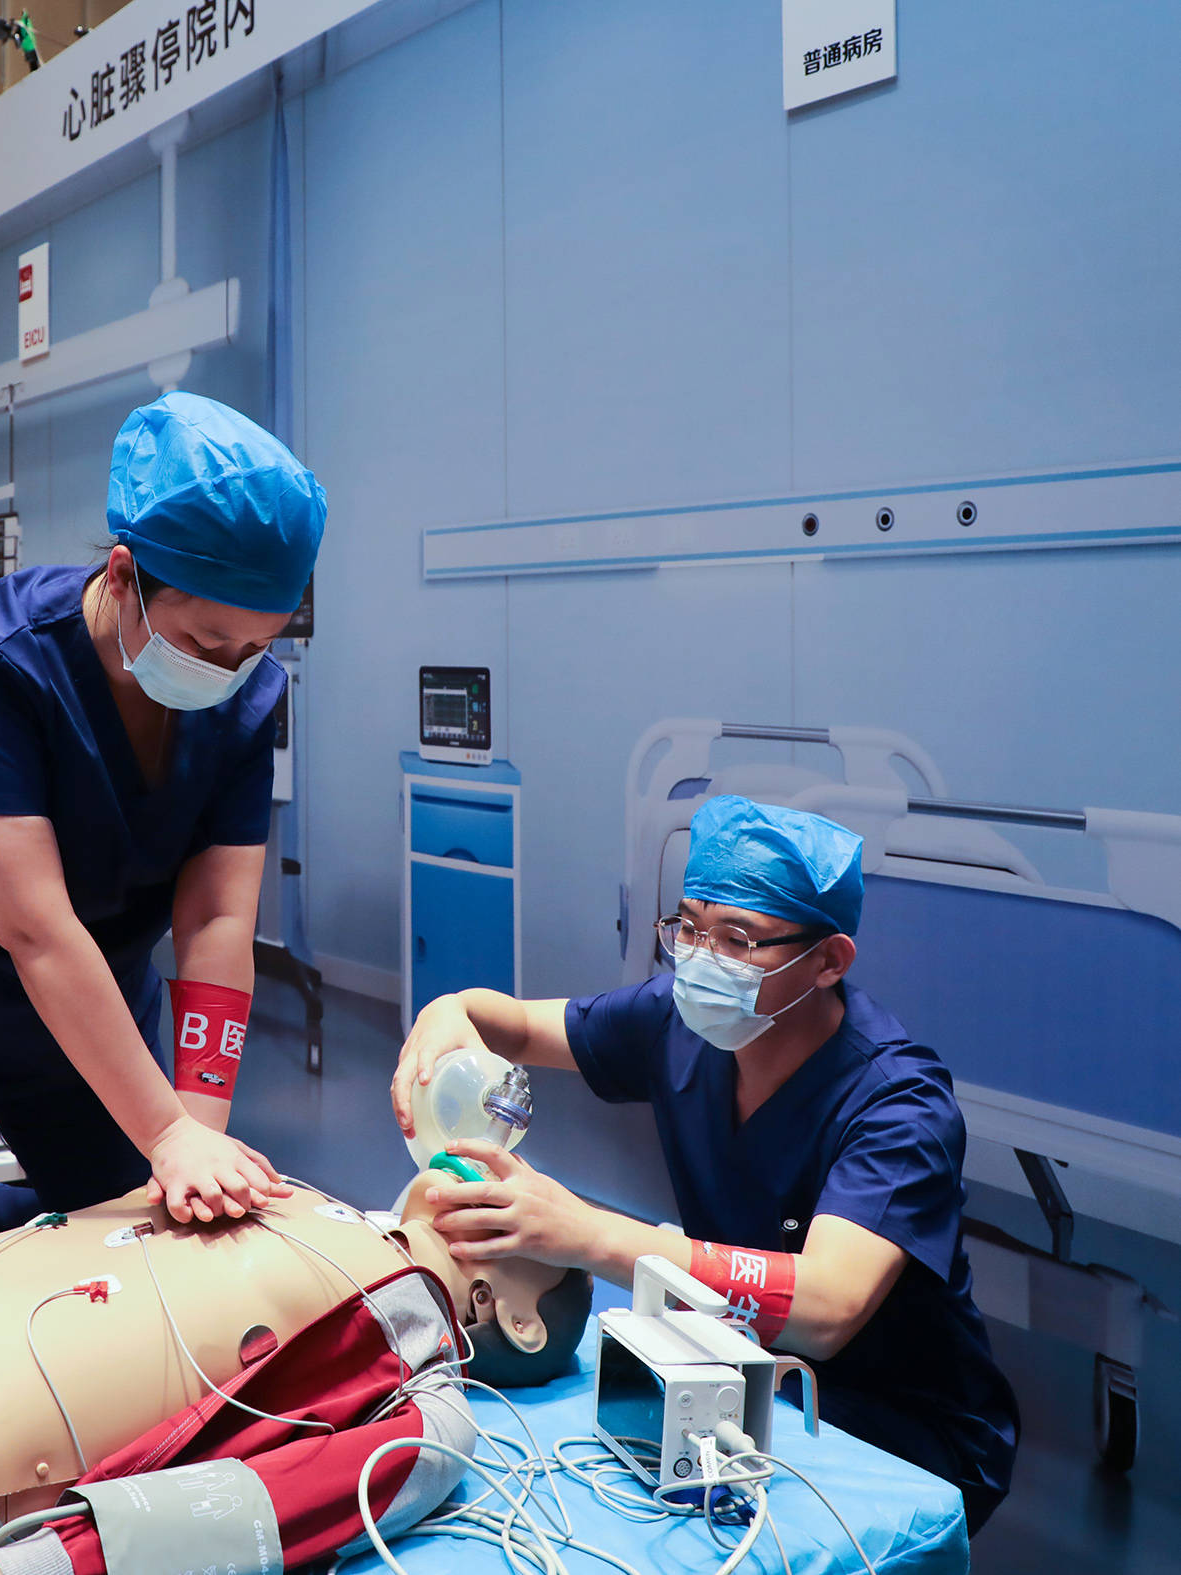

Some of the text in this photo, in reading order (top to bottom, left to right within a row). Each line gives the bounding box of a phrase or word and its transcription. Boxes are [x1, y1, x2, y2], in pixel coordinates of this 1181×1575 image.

[803, 28, 883, 76] 普通病房
[24, 326, 45, 350] EICU
[179, 1012, 209, 1050] B
